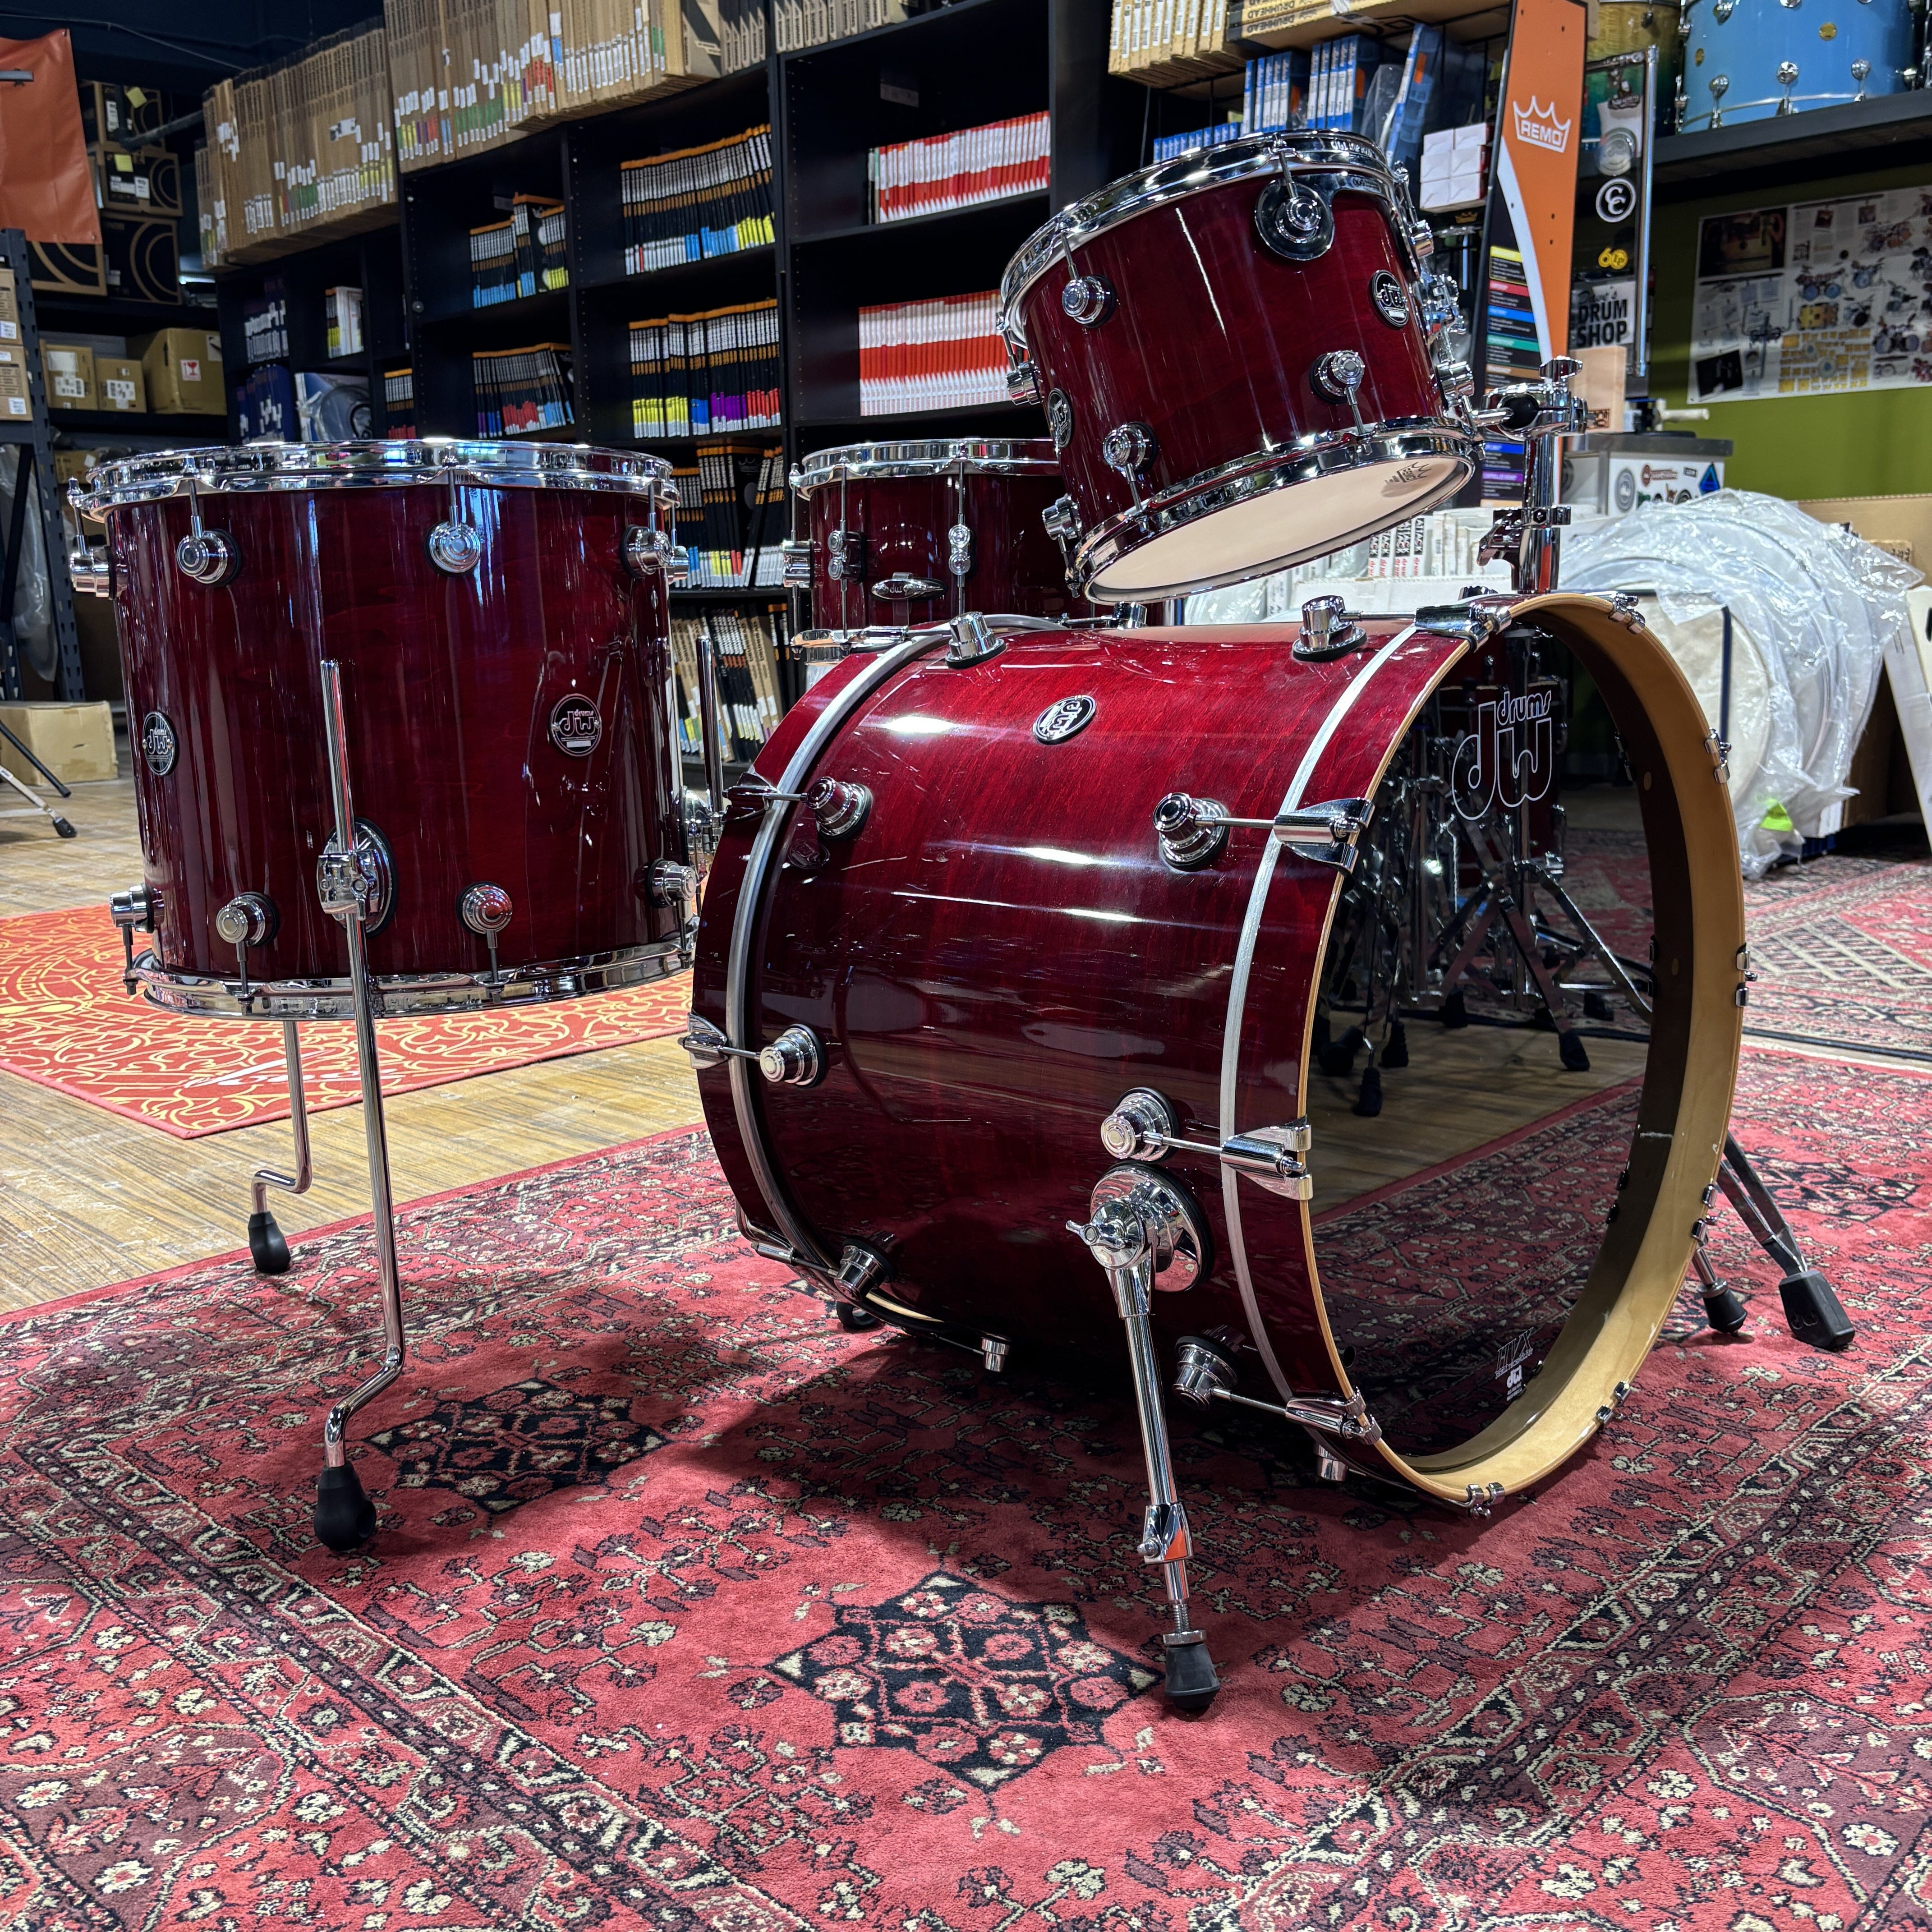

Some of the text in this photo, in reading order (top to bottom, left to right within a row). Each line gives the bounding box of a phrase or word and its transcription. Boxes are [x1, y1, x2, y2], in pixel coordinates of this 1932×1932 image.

[1521, 120, 1563, 146] REMO
[1578, 299, 1627, 323] DRUM
[1577, 321, 1627, 347] SHOP
[1415, 520, 1424, 551] ATTACK
[890, 584, 902, 593] dw
[1497, 690, 1551, 726] drums
[560, 711, 595, 736] dw
[146, 729, 169, 754] dw
[1452, 701, 1552, 820] dw
[1495, 1327, 1534, 1374] HVX
[1506, 1365, 1522, 1388] dw
